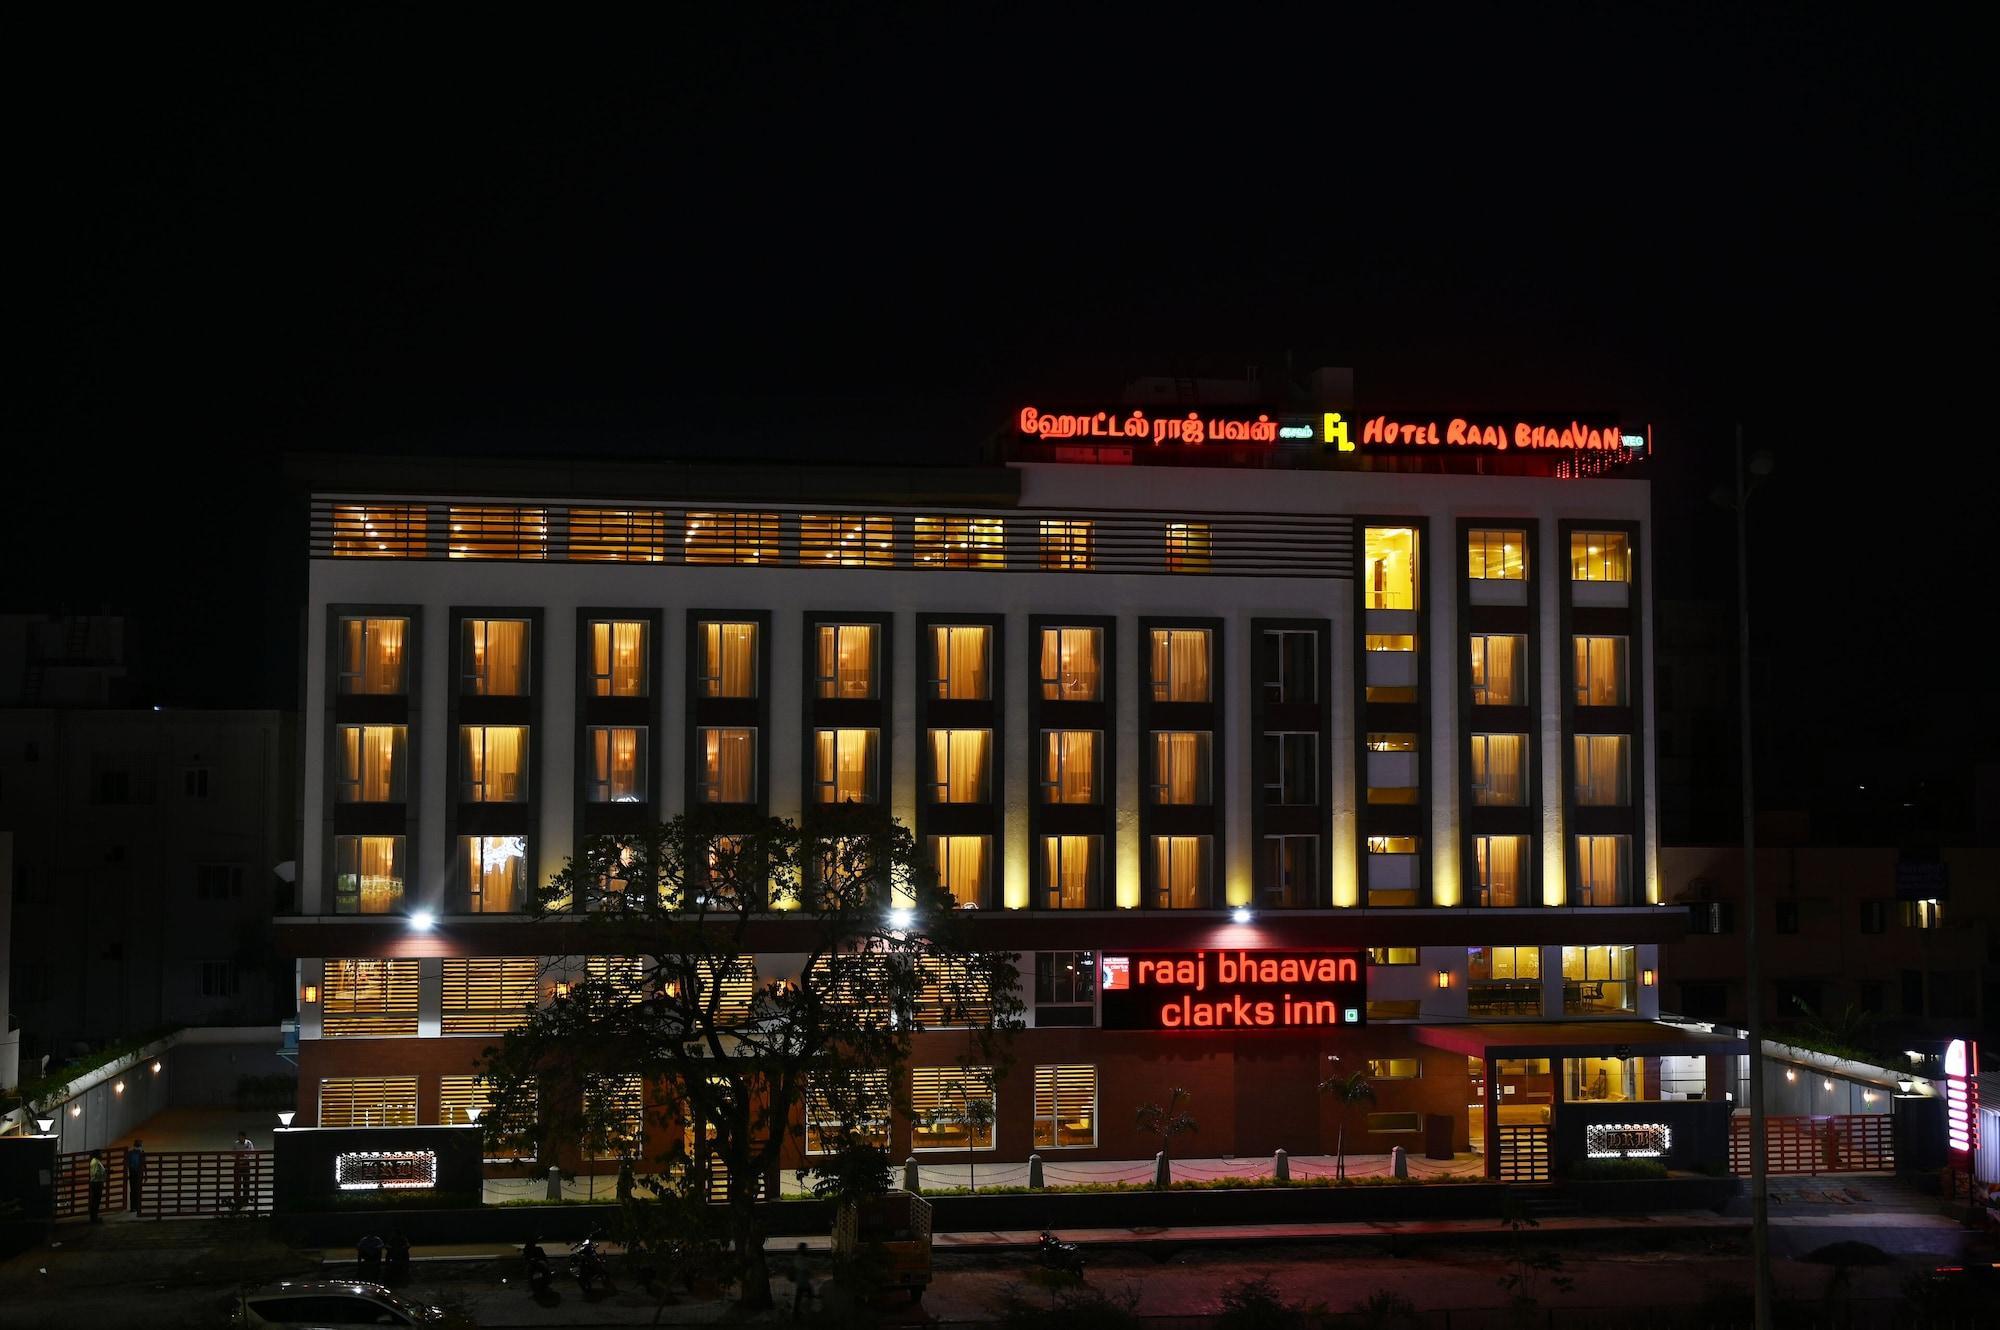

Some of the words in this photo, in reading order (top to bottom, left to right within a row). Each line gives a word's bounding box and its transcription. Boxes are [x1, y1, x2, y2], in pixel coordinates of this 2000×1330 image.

[1020, 407, 1149, 439] ஹோட்டல்
[1153, 412, 1204, 444] ராஜ்
[1209, 414, 1277, 442] பவன்
[1446, 418, 1508, 450] RAAJ
[1139, 952, 1205, 991] raaj
[1219, 951, 1357, 984] bhaavan
[1161, 994, 1275, 1027] clarks
[1284, 993, 1336, 1025] inn
